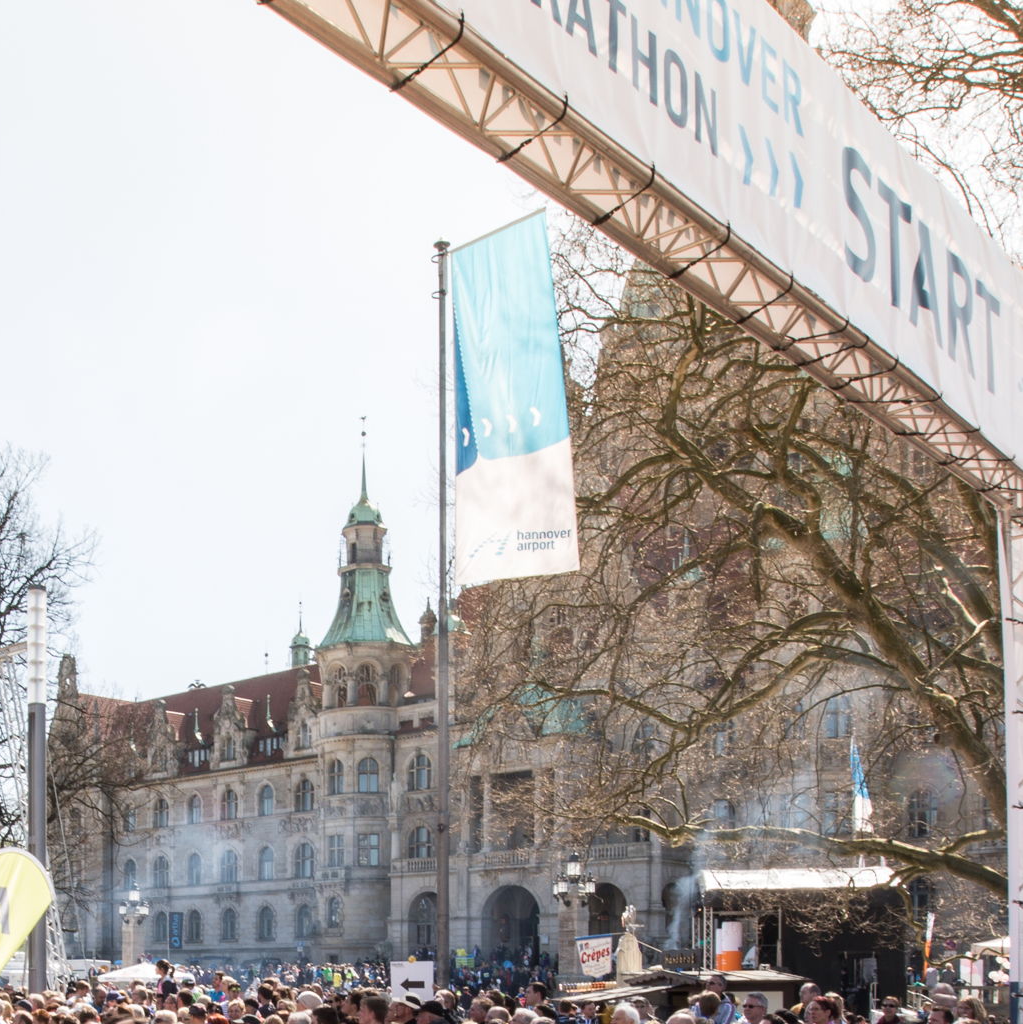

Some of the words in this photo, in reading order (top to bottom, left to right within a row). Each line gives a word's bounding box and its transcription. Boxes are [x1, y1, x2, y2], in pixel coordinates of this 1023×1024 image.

[529, 0, 719, 157] ATHON
[842, 146, 1000, 395] START
[517, 529, 571, 540] hannover
[517, 540, 555, 552] airport
[581, 947, 610, 964] Crêpes
